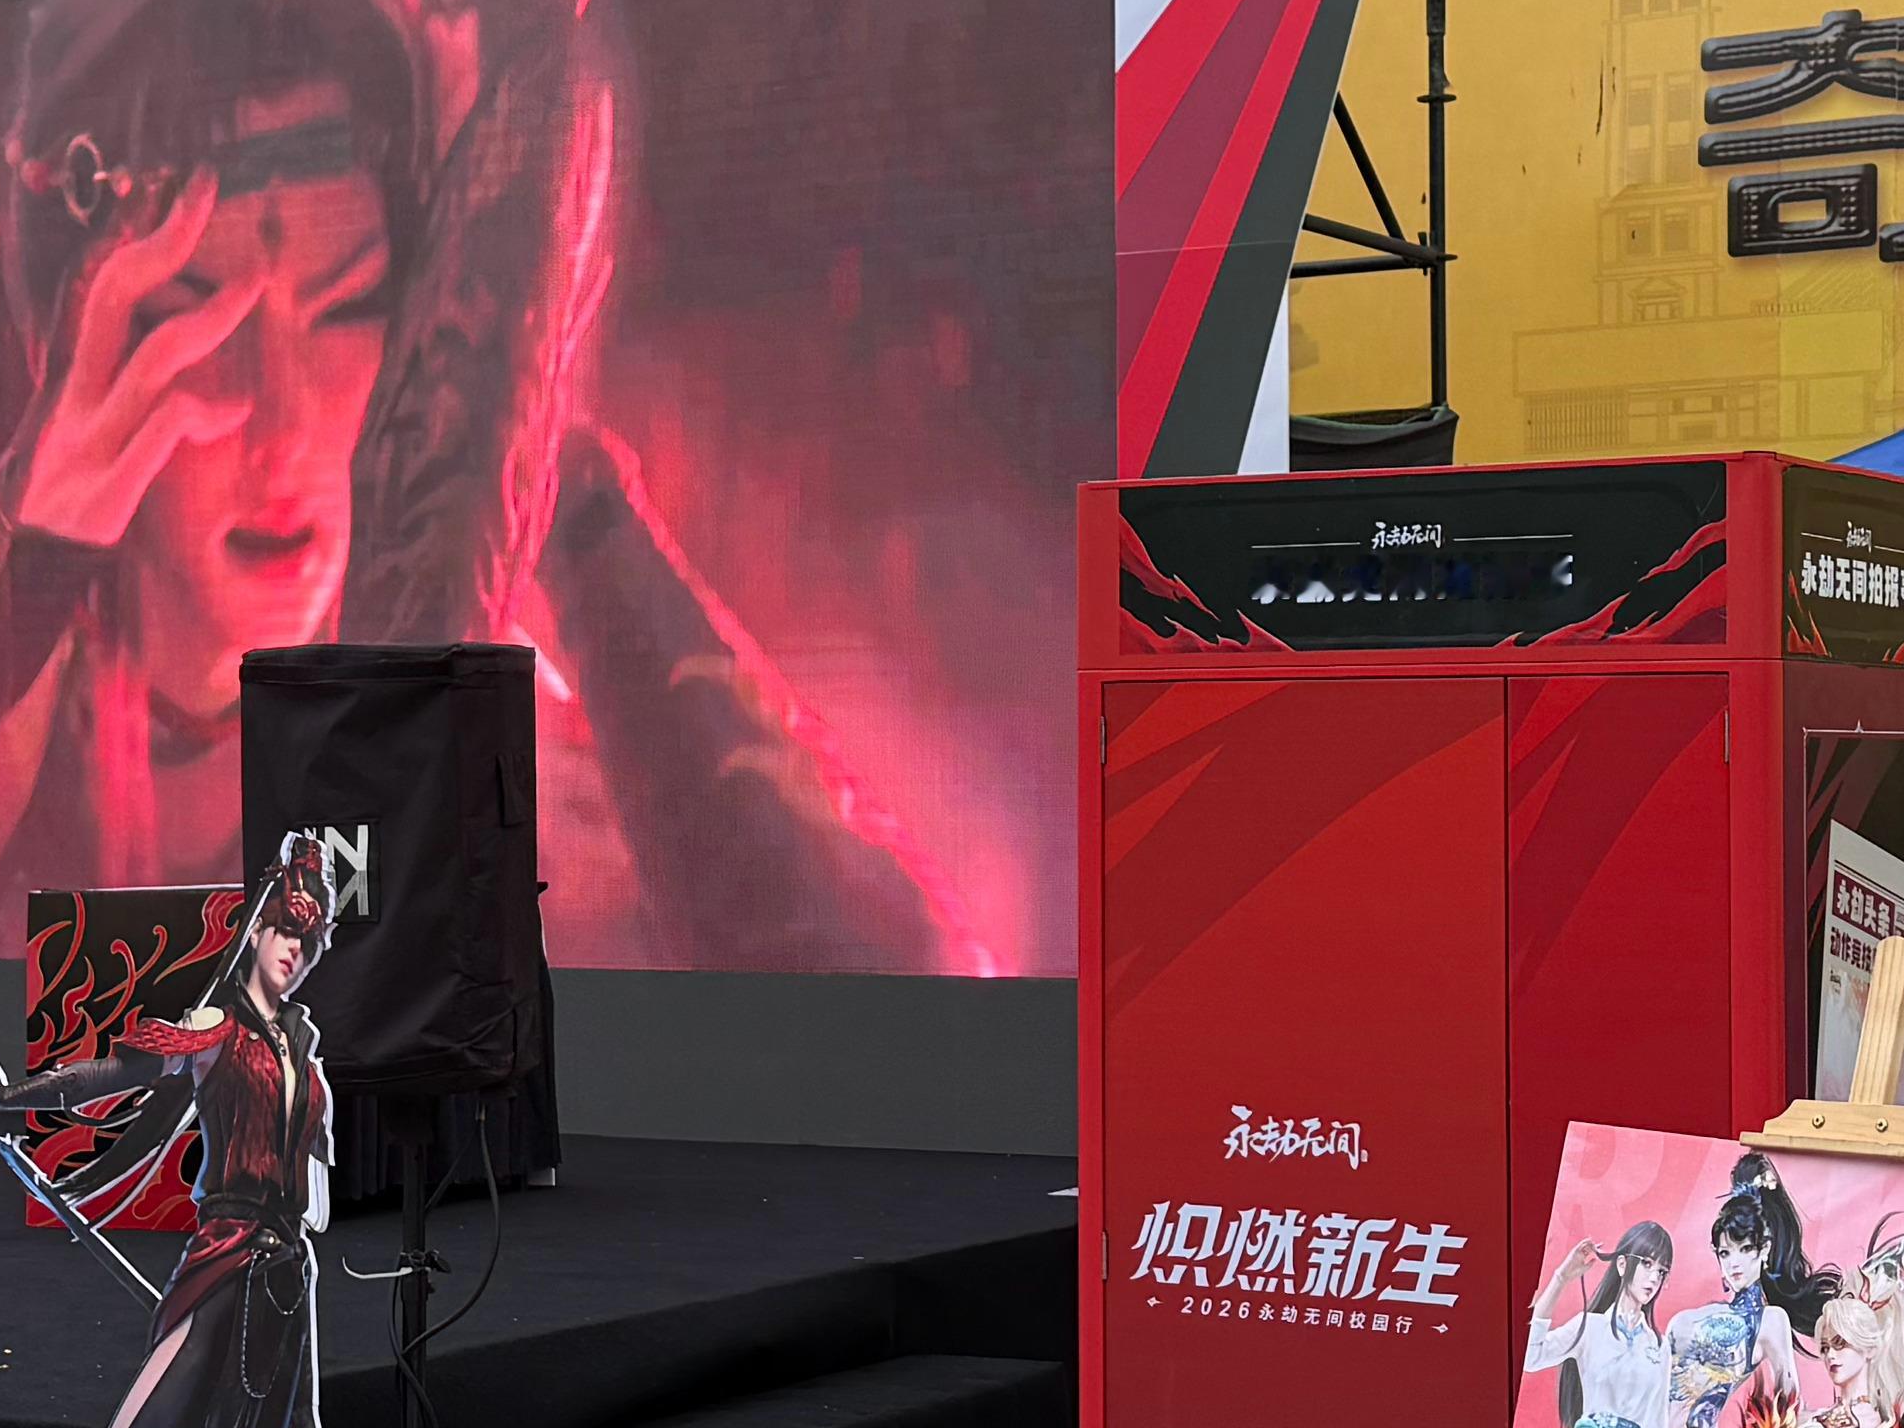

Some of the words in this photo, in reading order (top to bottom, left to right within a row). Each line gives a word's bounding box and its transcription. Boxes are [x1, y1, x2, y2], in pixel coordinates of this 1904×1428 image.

[1223, 1104, 1361, 1170] 永劫无间
[1129, 1200, 1469, 1307] 炽燃新生
